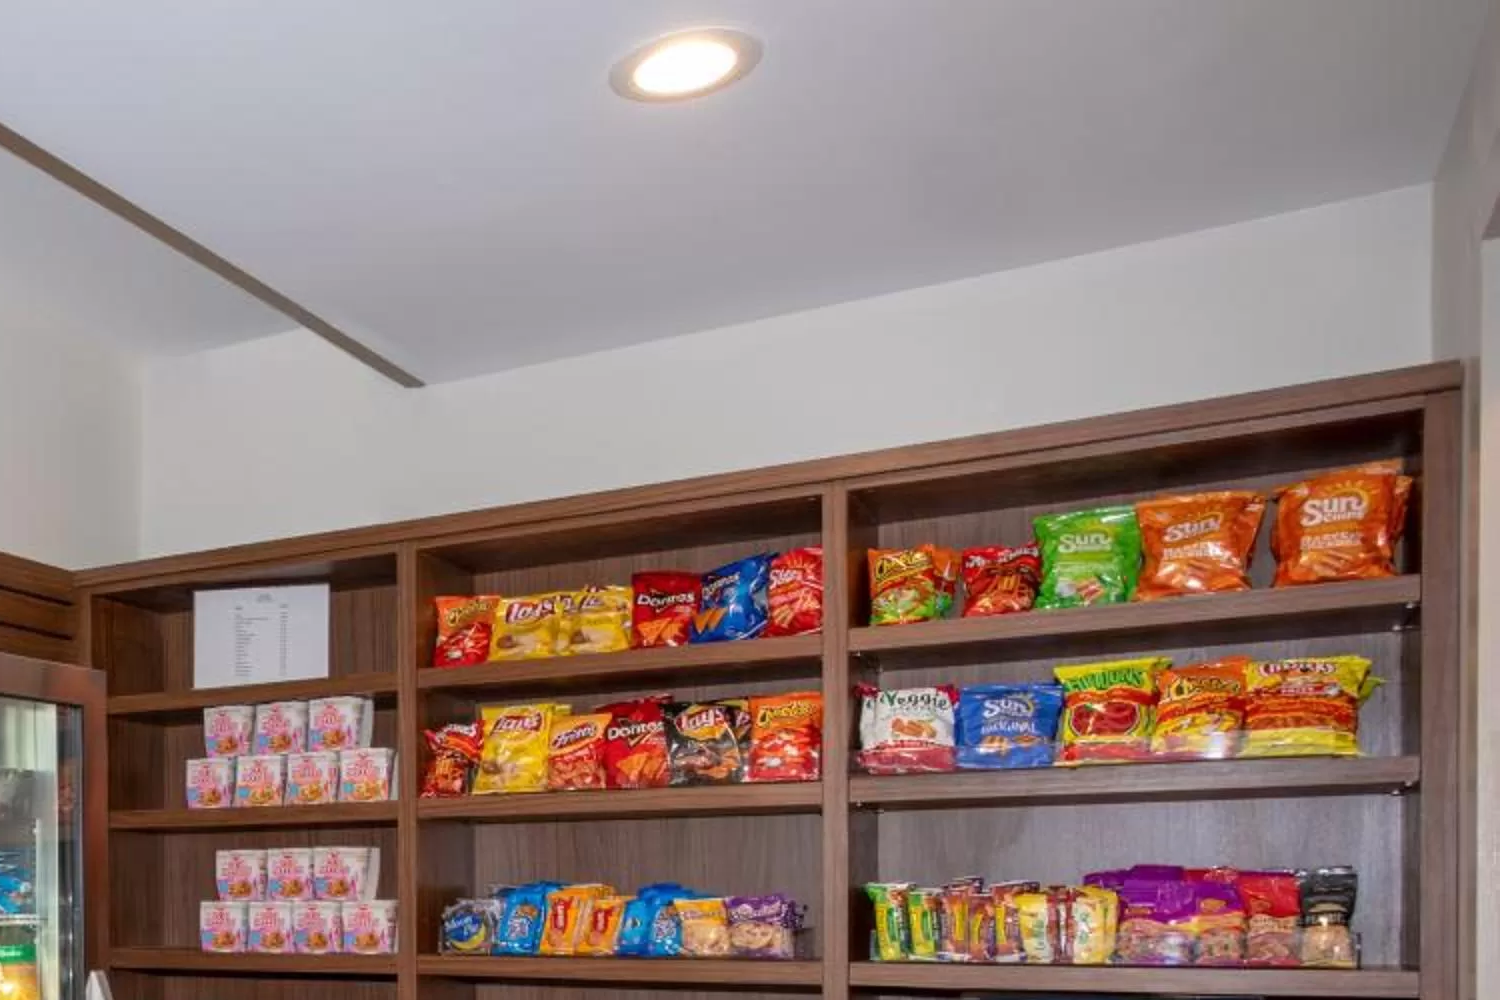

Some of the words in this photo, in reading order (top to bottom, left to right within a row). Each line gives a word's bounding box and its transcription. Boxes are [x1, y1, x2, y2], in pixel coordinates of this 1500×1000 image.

[1301, 495, 1365, 527] Sun
[1058, 533, 1112, 553] Sun
[636, 592, 696, 607] Doritos
[878, 690, 950, 713] Veggie
[982, 696, 1033, 719] Sun
